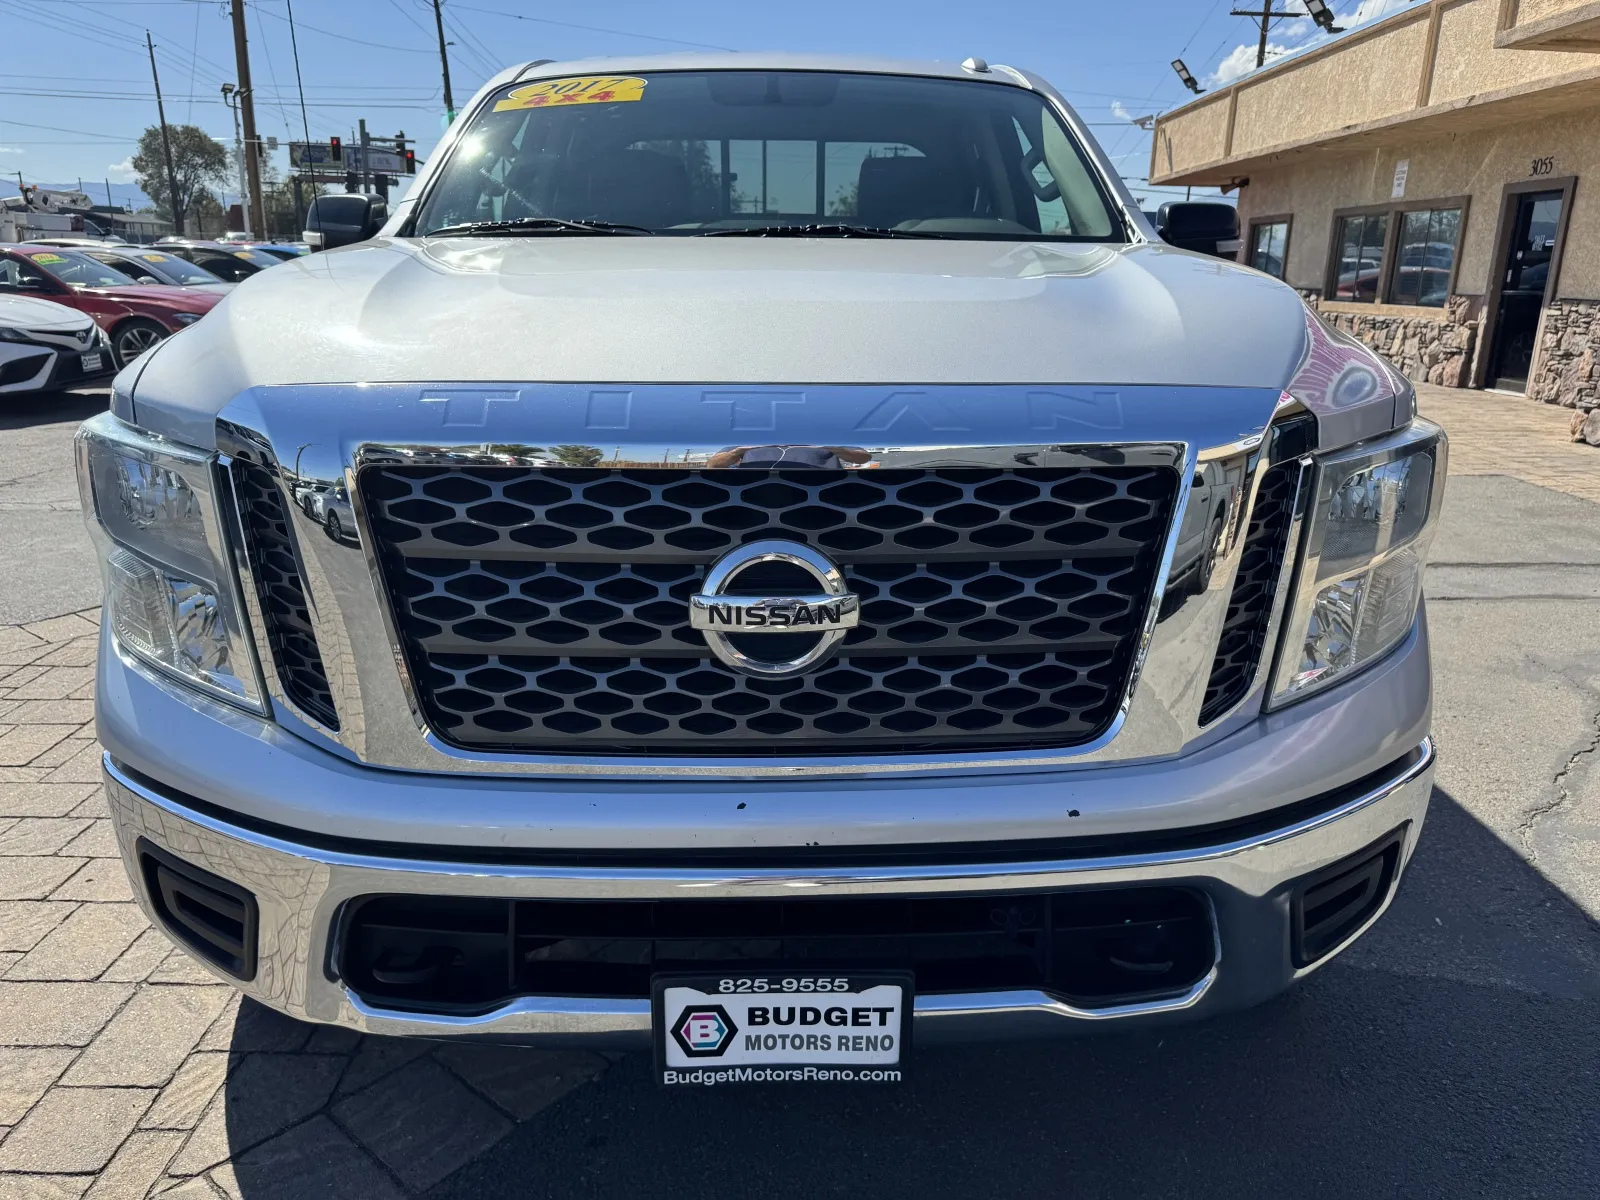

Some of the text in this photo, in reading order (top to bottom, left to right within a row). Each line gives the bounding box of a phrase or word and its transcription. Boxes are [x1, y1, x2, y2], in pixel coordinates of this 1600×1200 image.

[528, 79, 628, 98] 2017
[1529, 156, 1555, 176] 3055
[418, 389, 1123, 431] TITAN
[708, 604, 841, 625] NISSAN
[718, 978, 849, 993] 825-9555
[747, 1006, 895, 1027] BUDGET
[689, 1018, 721, 1044] B
[744, 1033, 894, 1052] MOTORS RENO
[663, 1067, 902, 1086] BudgetMotorsReno.com
